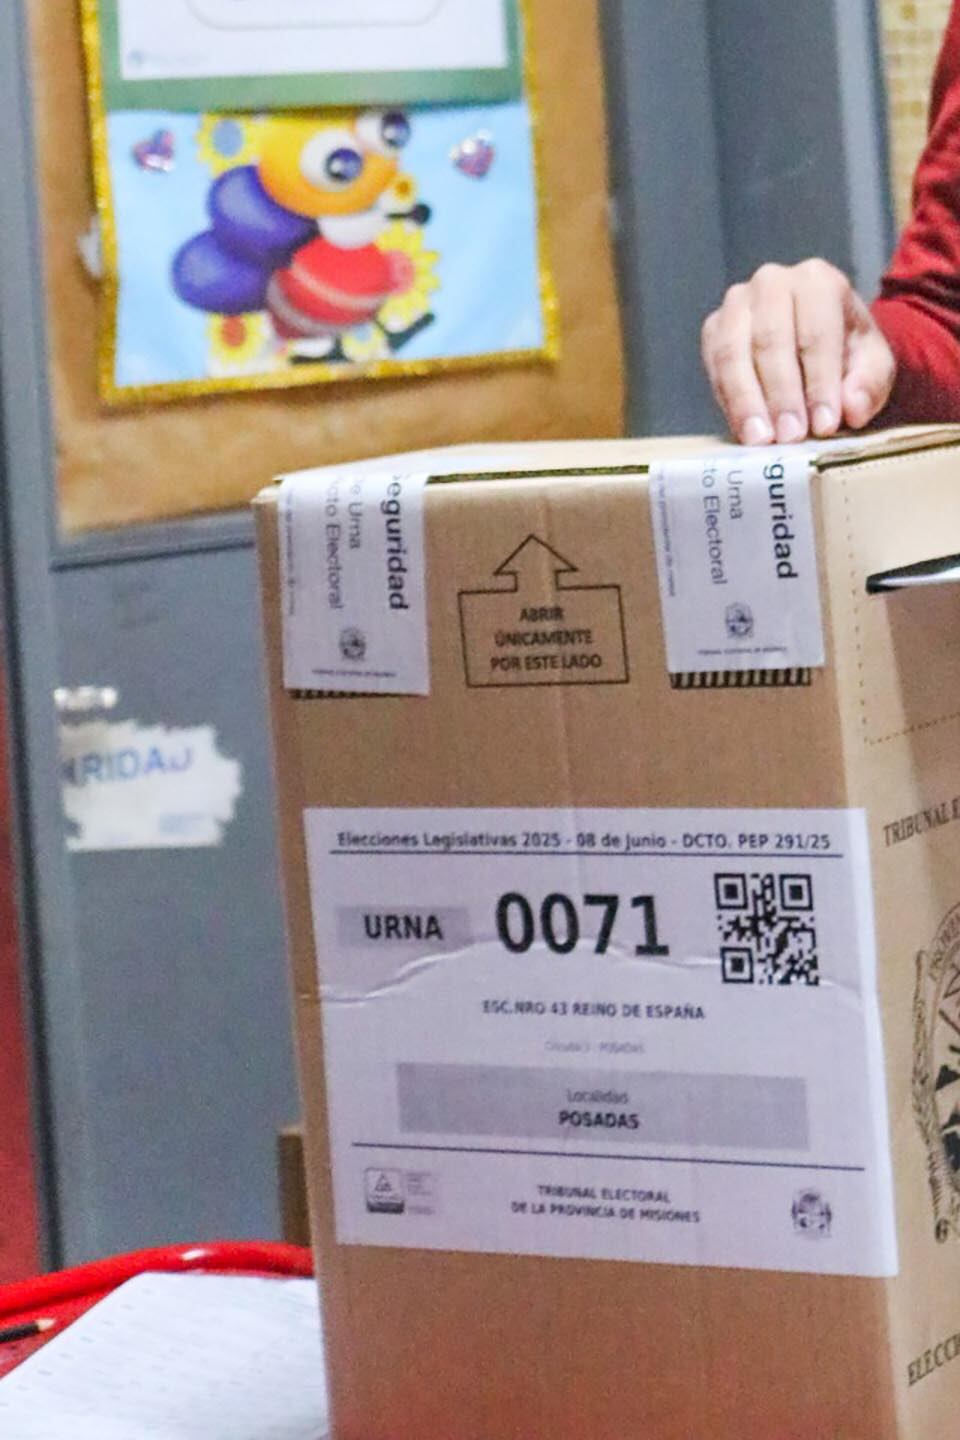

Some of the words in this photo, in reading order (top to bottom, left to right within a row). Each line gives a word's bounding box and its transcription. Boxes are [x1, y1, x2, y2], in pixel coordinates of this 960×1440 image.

[727, 468, 744, 521] Urna
[703, 495, 729, 586] Electoral
[326, 523, 345, 611] Electoral
[519, 607, 565, 622] ABRIR
[494, 628, 593, 648] ÚNICAMENTE
[490, 657, 522, 671] POR
[525, 655, 558, 670] ESTE
[562, 653, 603, 670] LADO
[882, 803, 950, 847] TRIBUNAL
[337, 832, 418, 847] Elecciones
[424, 832, 517, 851] Legislativas
[522, 832, 561, 847] 2025
[576, 833, 596, 848] 08
[601, 833, 620, 848] de
[682, 833, 732, 848] DCTO.
[738, 834, 769, 849] PEP
[774, 834, 831, 851] 291/25
[364, 914, 444, 941] URNA
[496, 891, 670, 956] 0071
[572, 1001, 617, 1018] REINO
[622, 1003, 640, 1018] DE
[646, 1002, 706, 1020] ESPAÑA
[558, 1110, 640, 1129] POSADAS
[537, 1184, 597, 1199] TRIBUNAL
[601, 1187, 672, 1203] ELECTORAL
[511, 1201, 528, 1214] DE
[531, 1203, 546, 1215] LA
[550, 1203, 615, 1218] PROVINCIA
[619, 1206, 636, 1220] DE
[639, 1207, 701, 1224] MISIONES
